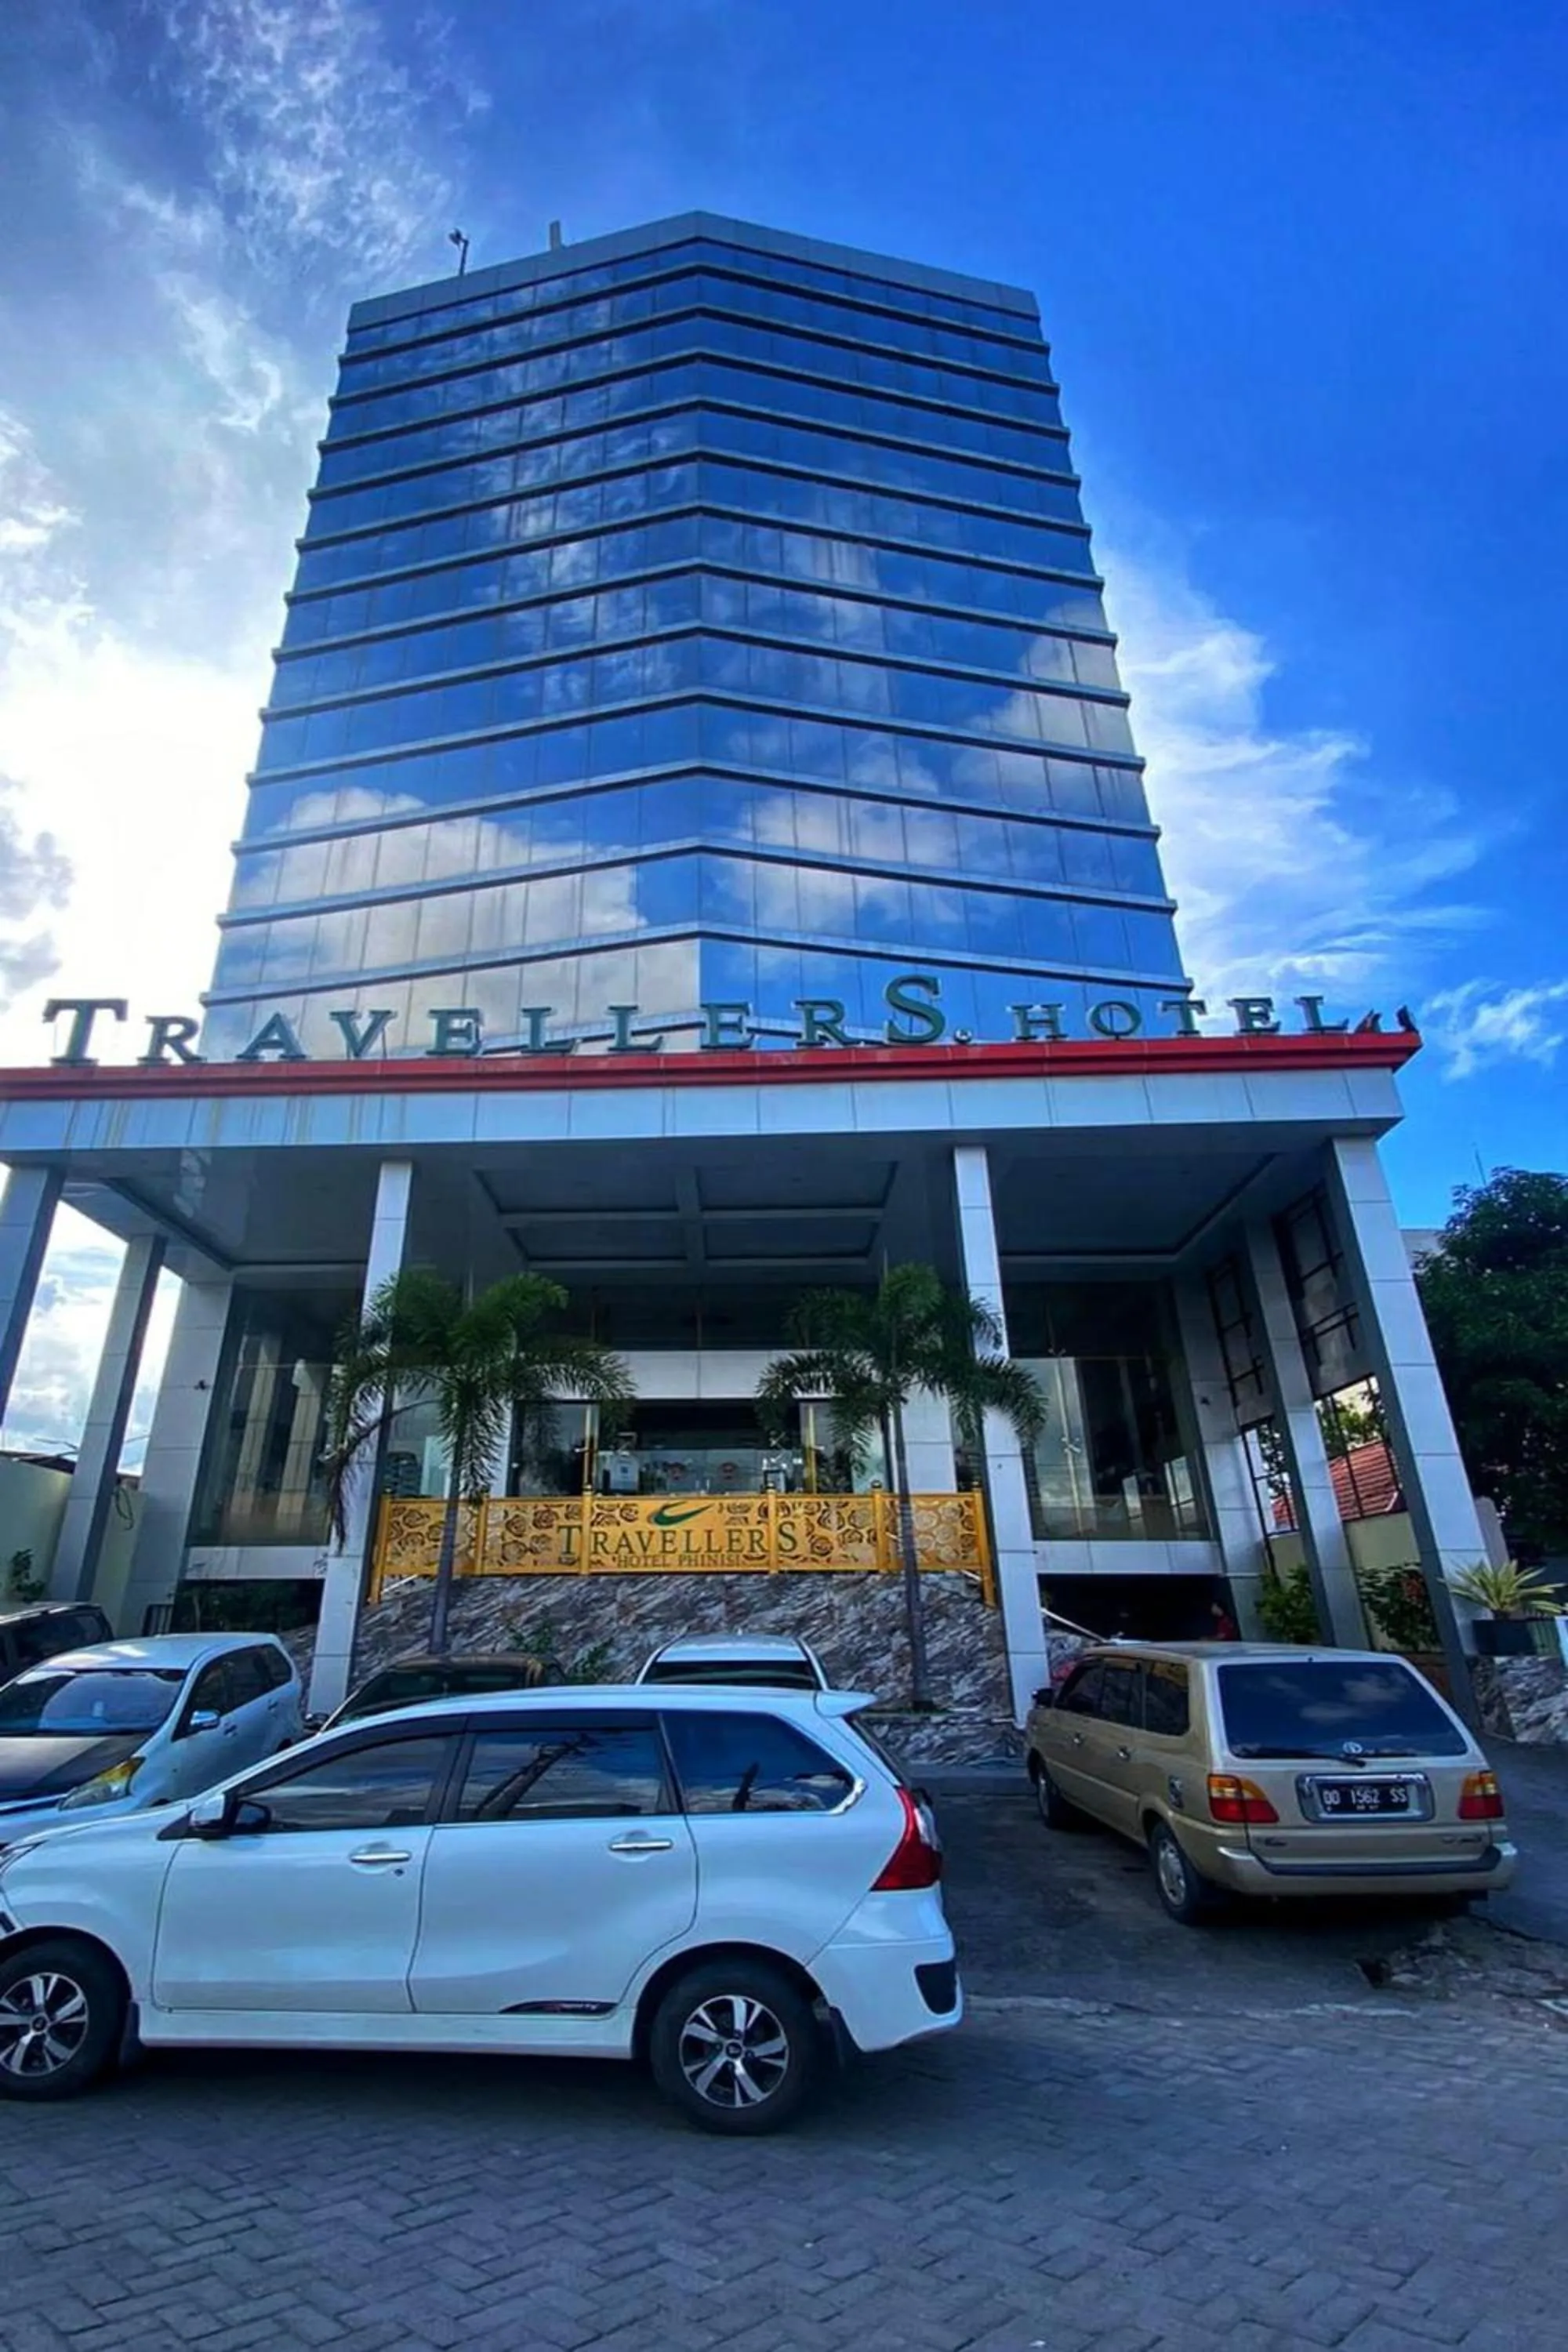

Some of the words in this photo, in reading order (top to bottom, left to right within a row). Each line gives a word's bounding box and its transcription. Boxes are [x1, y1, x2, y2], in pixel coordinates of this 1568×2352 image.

[42, 975, 948, 1068] TRAVELLERS
[1011, 995, 1348, 1041] HOTEL
[557, 1521, 798, 1555] TRAVELLERS
[616, 1554, 668, 1567] HOTEL
[678, 1553, 741, 1567] PHINISI
